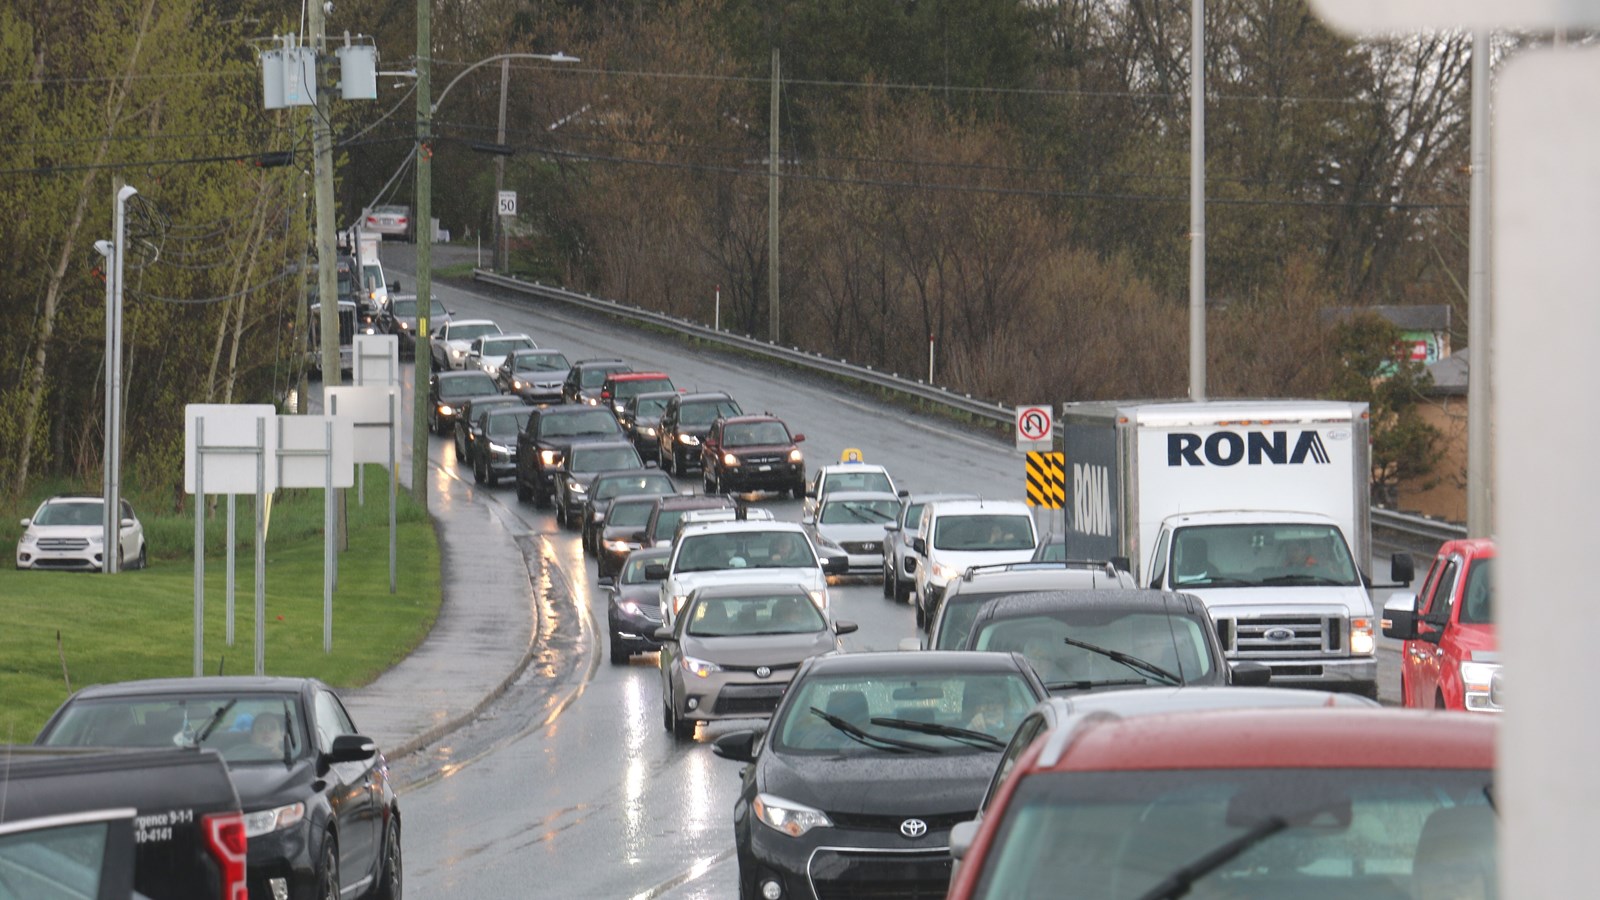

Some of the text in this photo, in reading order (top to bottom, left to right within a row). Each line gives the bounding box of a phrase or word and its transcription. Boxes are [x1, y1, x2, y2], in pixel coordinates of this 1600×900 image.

[501, 199, 514, 211] 50
[1167, 430, 1331, 467] RONA
[1073, 462, 1112, 537] RONA
[169, 809, 193, 824] 9-1-1
